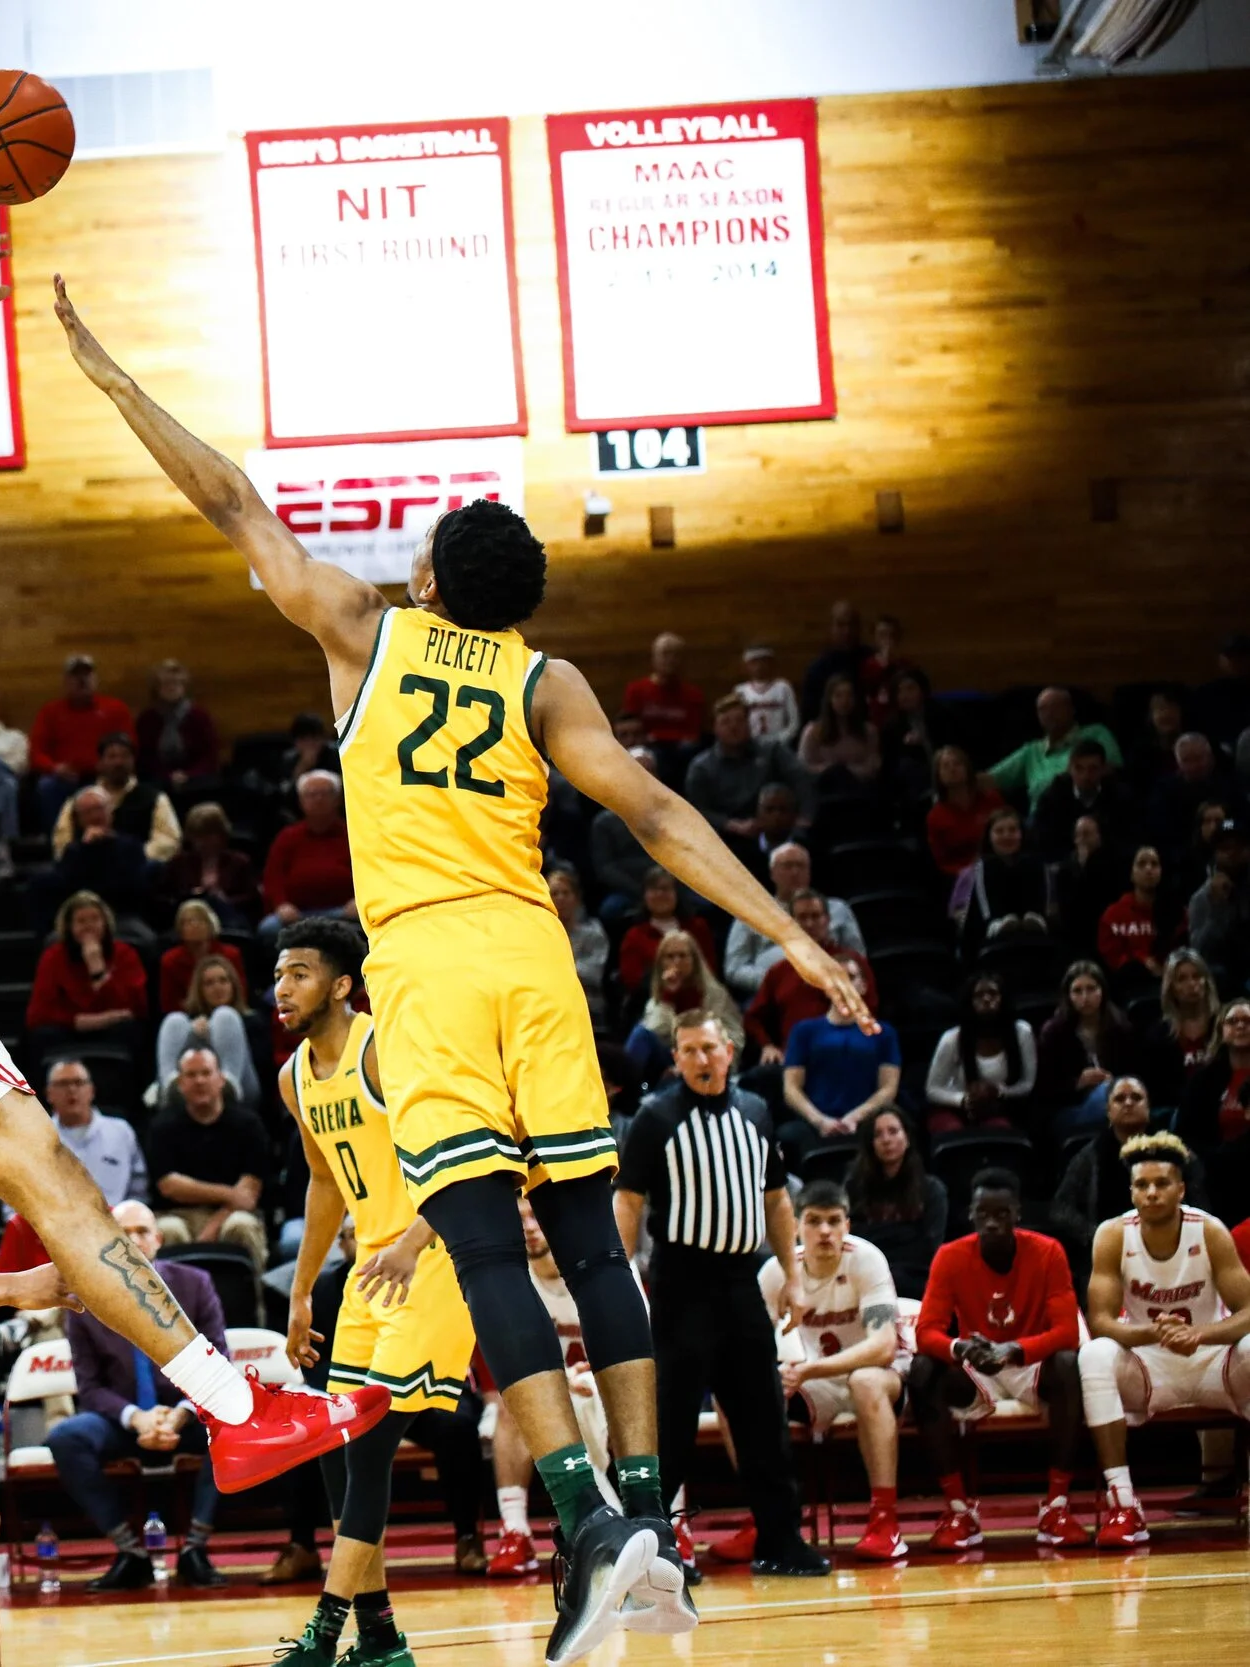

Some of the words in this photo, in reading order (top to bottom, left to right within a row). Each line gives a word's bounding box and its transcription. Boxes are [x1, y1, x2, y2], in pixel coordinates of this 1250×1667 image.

[585, 113, 777, 146] VOLLEYBALL
[635, 159, 735, 182] MAAC
[338, 184, 425, 221] NIT
[700, 187, 783, 208] SEASON
[383, 234, 488, 261] ROUND
[589, 215, 790, 252] CHAMPIONS
[607, 427, 692, 470] 104
[424, 627, 502, 676] PICKETT
[397, 673, 506, 798] 22
[309, 1097, 364, 1134] SIENA
[335, 1141, 368, 1200] 0
